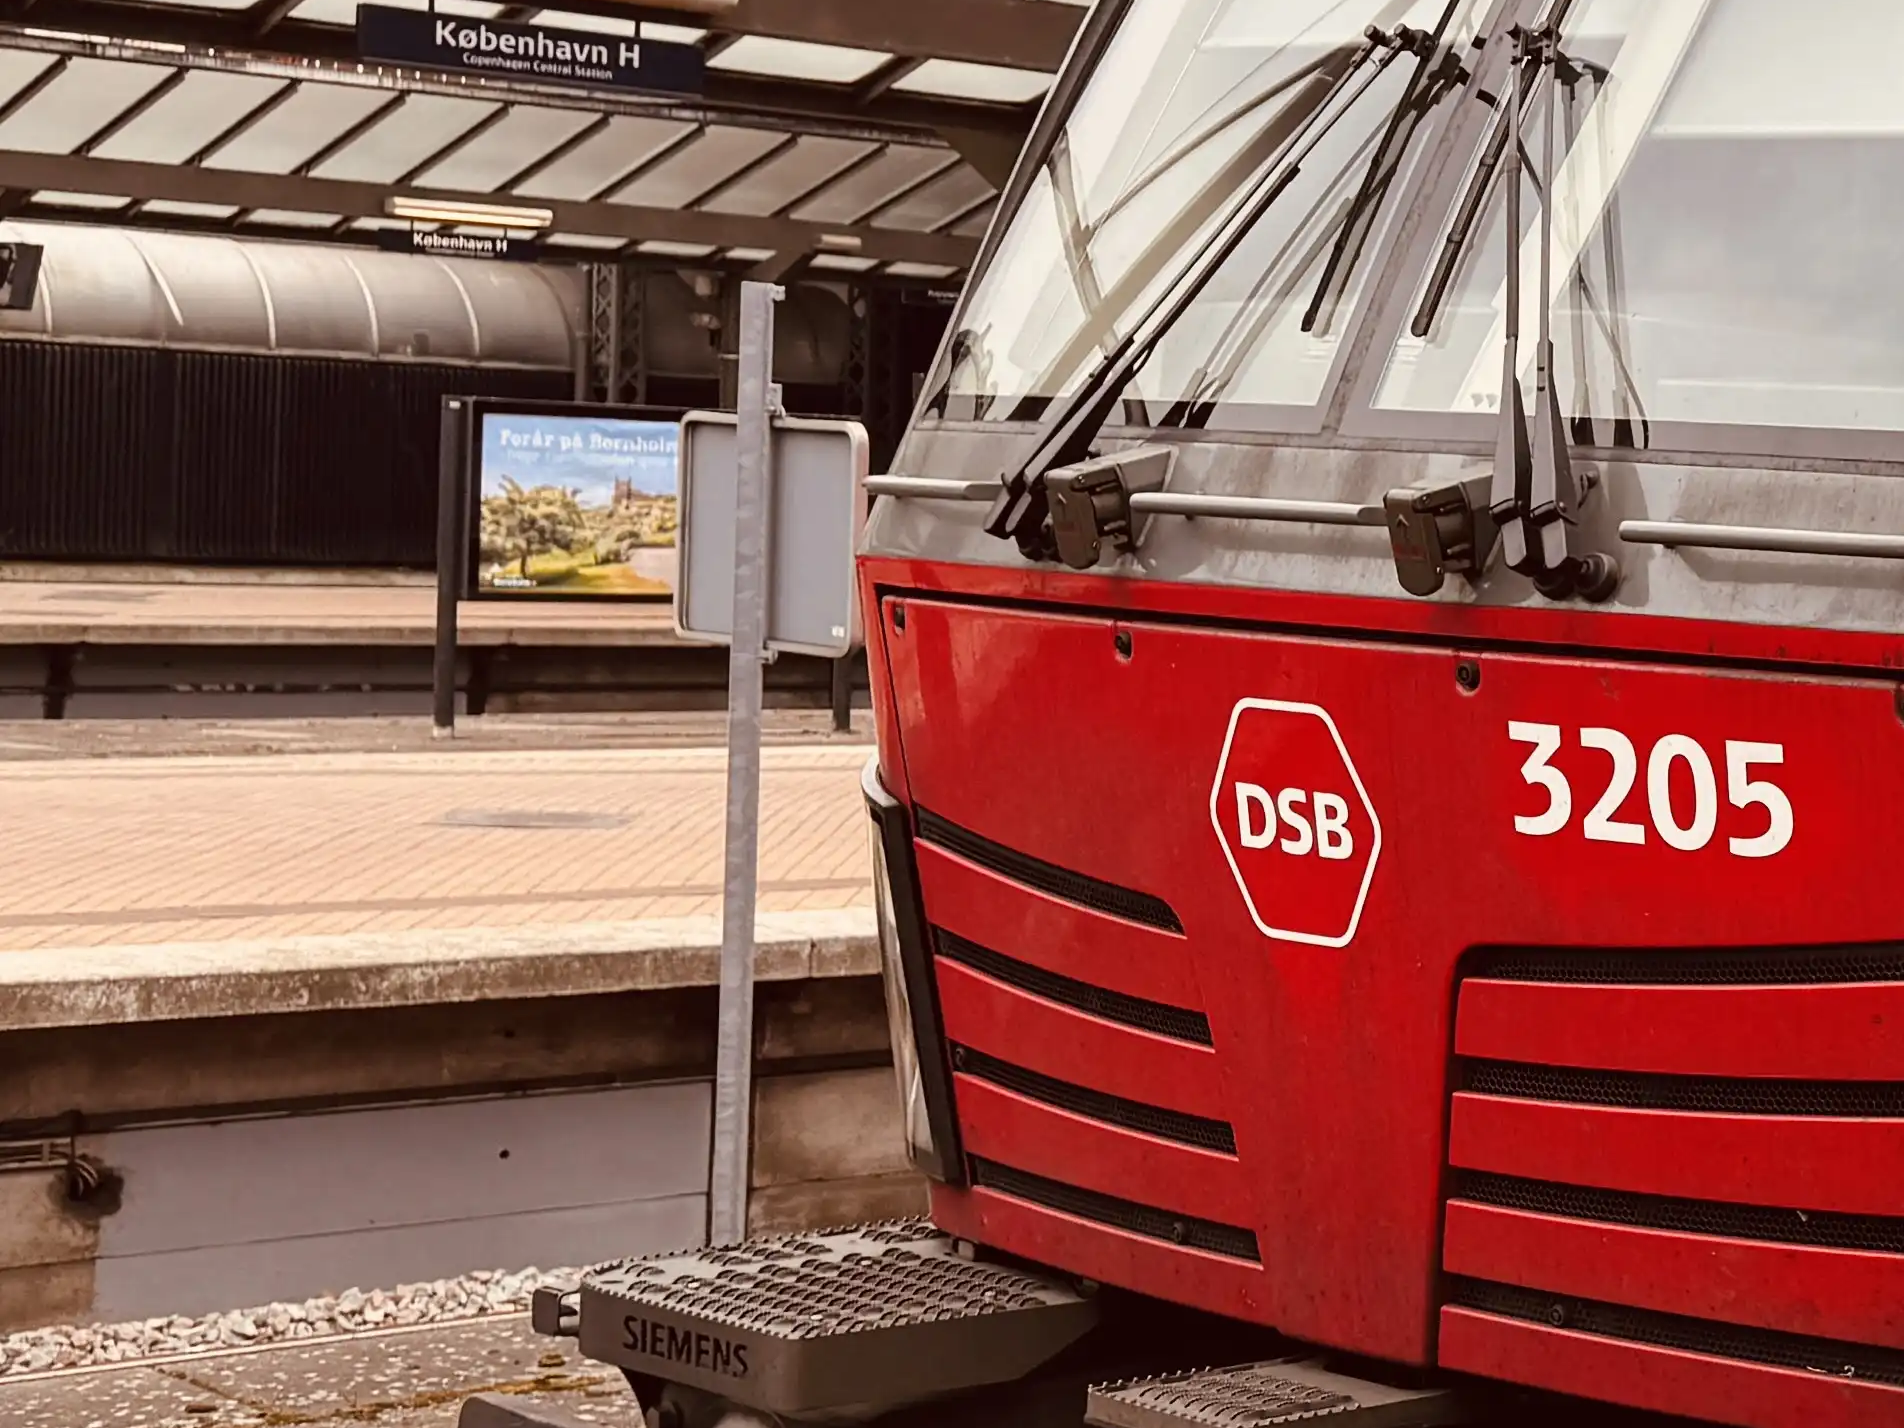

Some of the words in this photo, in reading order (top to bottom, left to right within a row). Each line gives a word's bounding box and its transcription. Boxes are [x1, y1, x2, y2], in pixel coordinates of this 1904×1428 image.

[435, 19, 609, 65] København
[618, 43, 641, 69] H
[462, 51, 531, 70] Copenhagen
[575, 64, 613, 80] Station
[413, 232, 493, 252] København
[1507, 720, 1795, 858] 3205
[1234, 781, 1354, 860] DSB
[622, 1314, 749, 1378] SIEMENS
